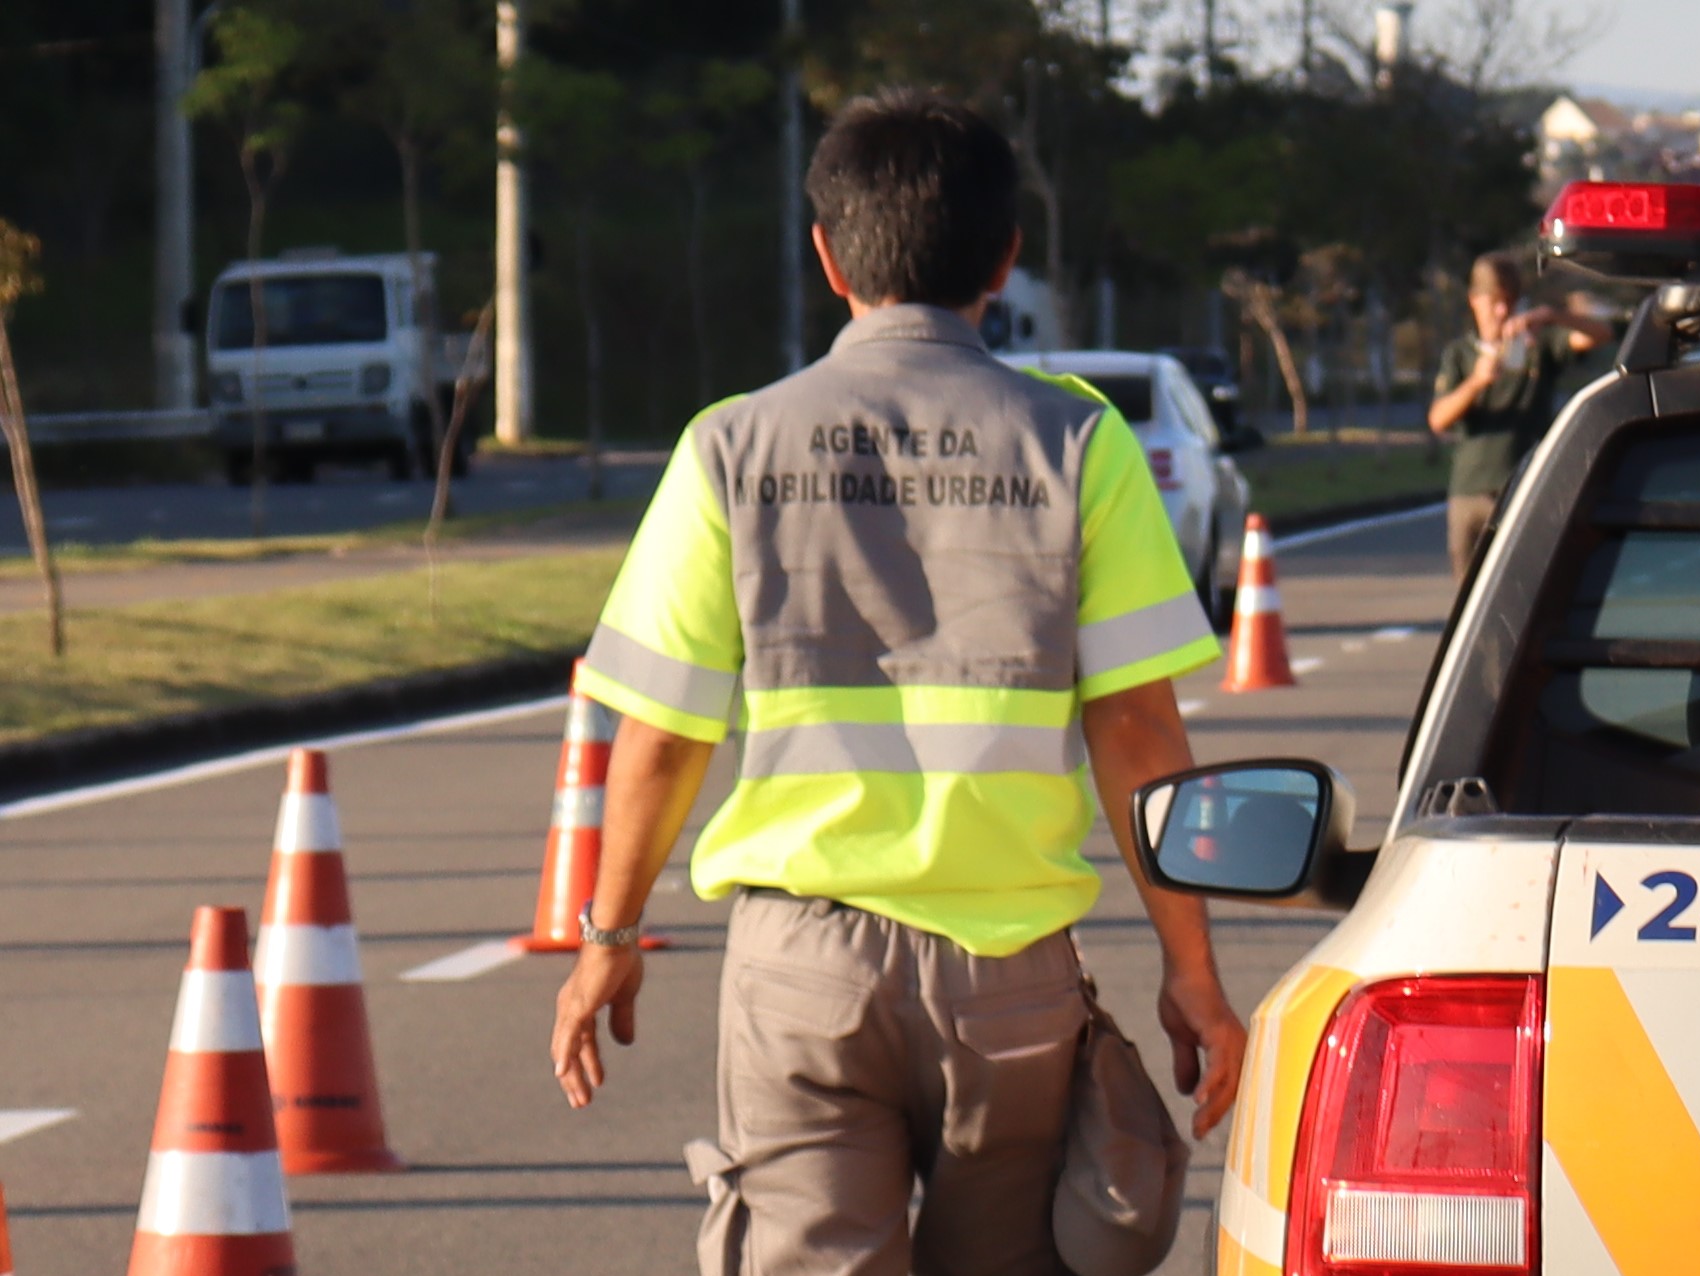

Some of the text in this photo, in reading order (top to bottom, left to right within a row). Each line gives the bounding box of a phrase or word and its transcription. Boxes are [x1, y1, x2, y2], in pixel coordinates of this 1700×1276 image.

[809, 422, 977, 458] AGENTE DA
[735, 473, 1051, 509] MOBILIDADE URBANA
